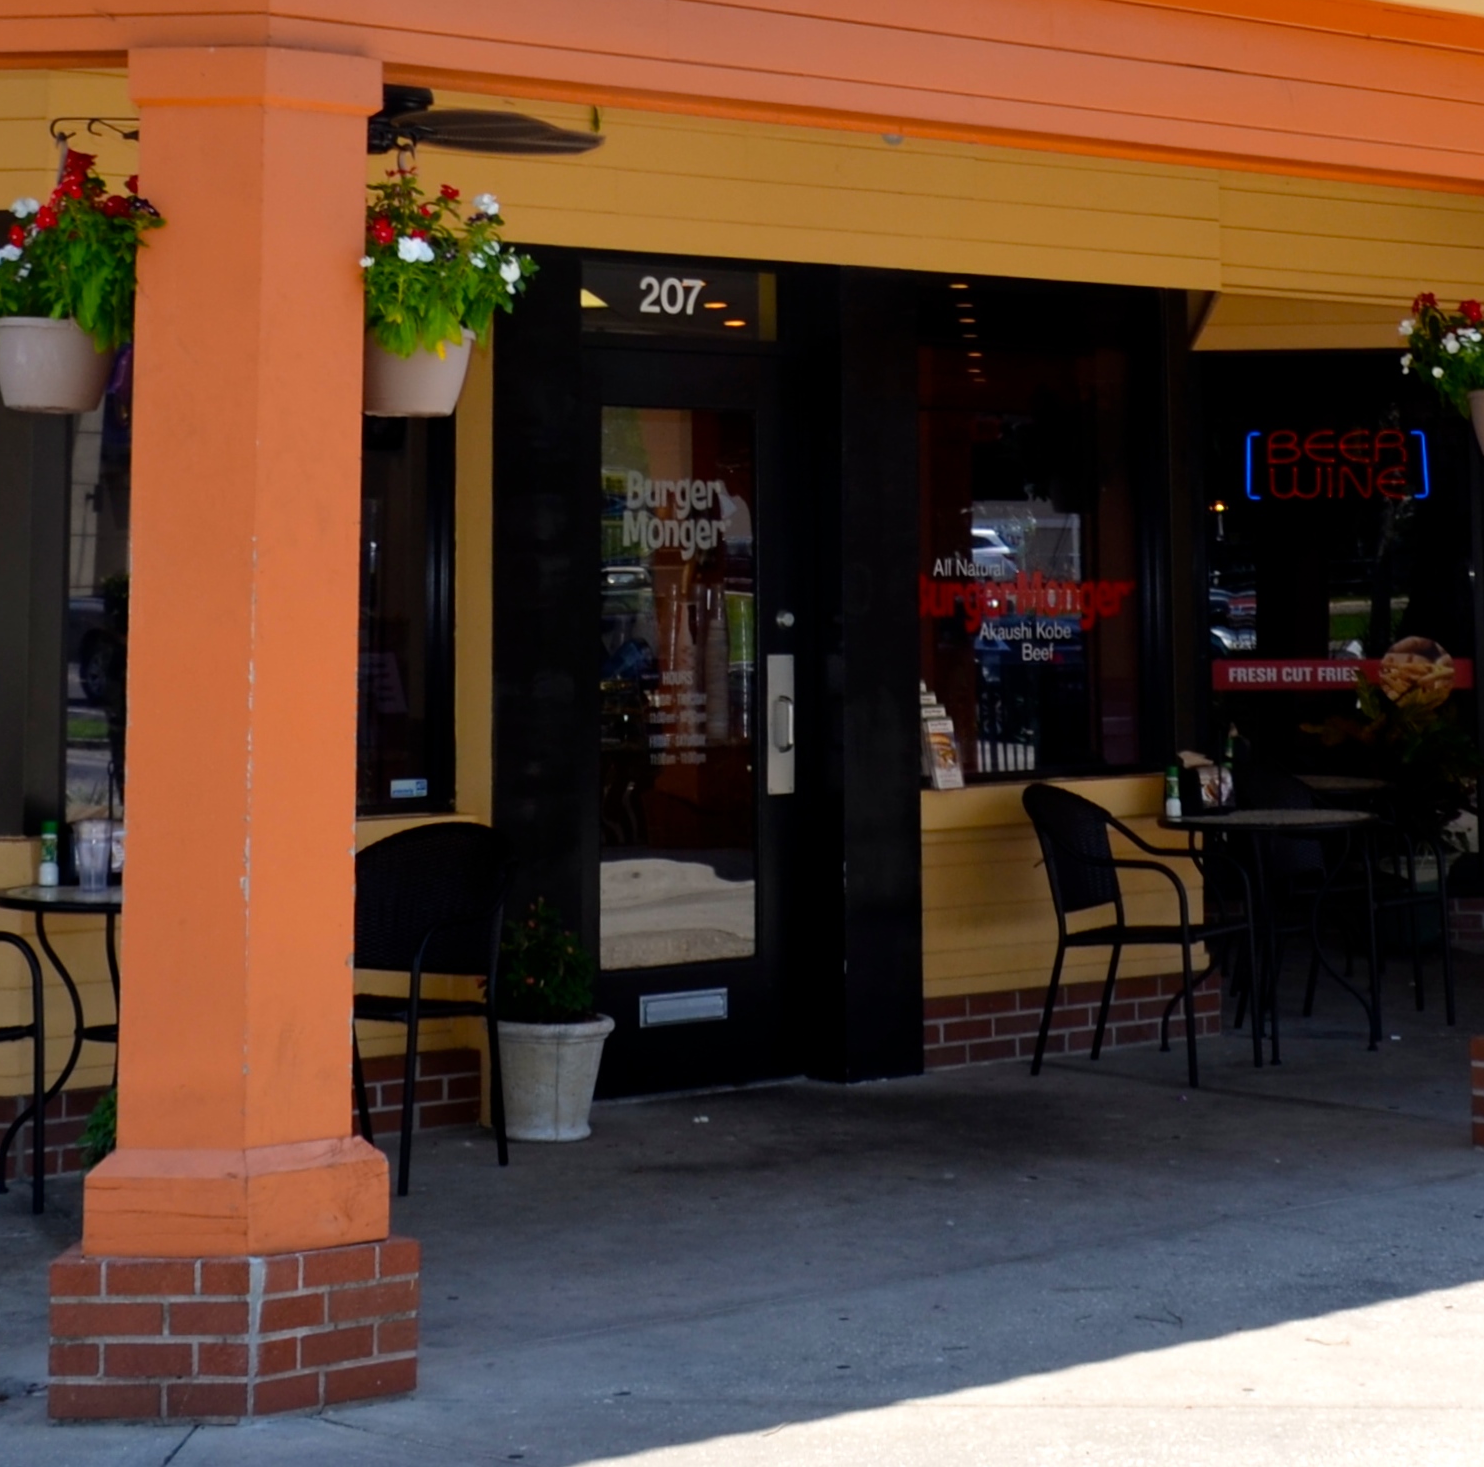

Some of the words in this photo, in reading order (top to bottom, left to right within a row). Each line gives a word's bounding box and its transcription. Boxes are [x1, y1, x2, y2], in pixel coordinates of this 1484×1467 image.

[639, 275, 705, 316] 207
[1267, 429, 1409, 464] BEER
[626, 470, 722, 519] Burger
[1268, 465, 1408, 500] WINE
[622, 511, 727, 561] Monger
[932, 558, 952, 578] All
[955, 558, 1006, 578] Natural
[979, 621, 1033, 641] Akaushi
[1036, 621, 1072, 641] Kobe
[1021, 642, 1055, 662] Beef
[662, 670, 695, 687] HOURS
[1228, 666, 1277, 683] FRESH
[1282, 666, 1313, 683] CUT
[1317, 665, 1360, 682] FRIES
